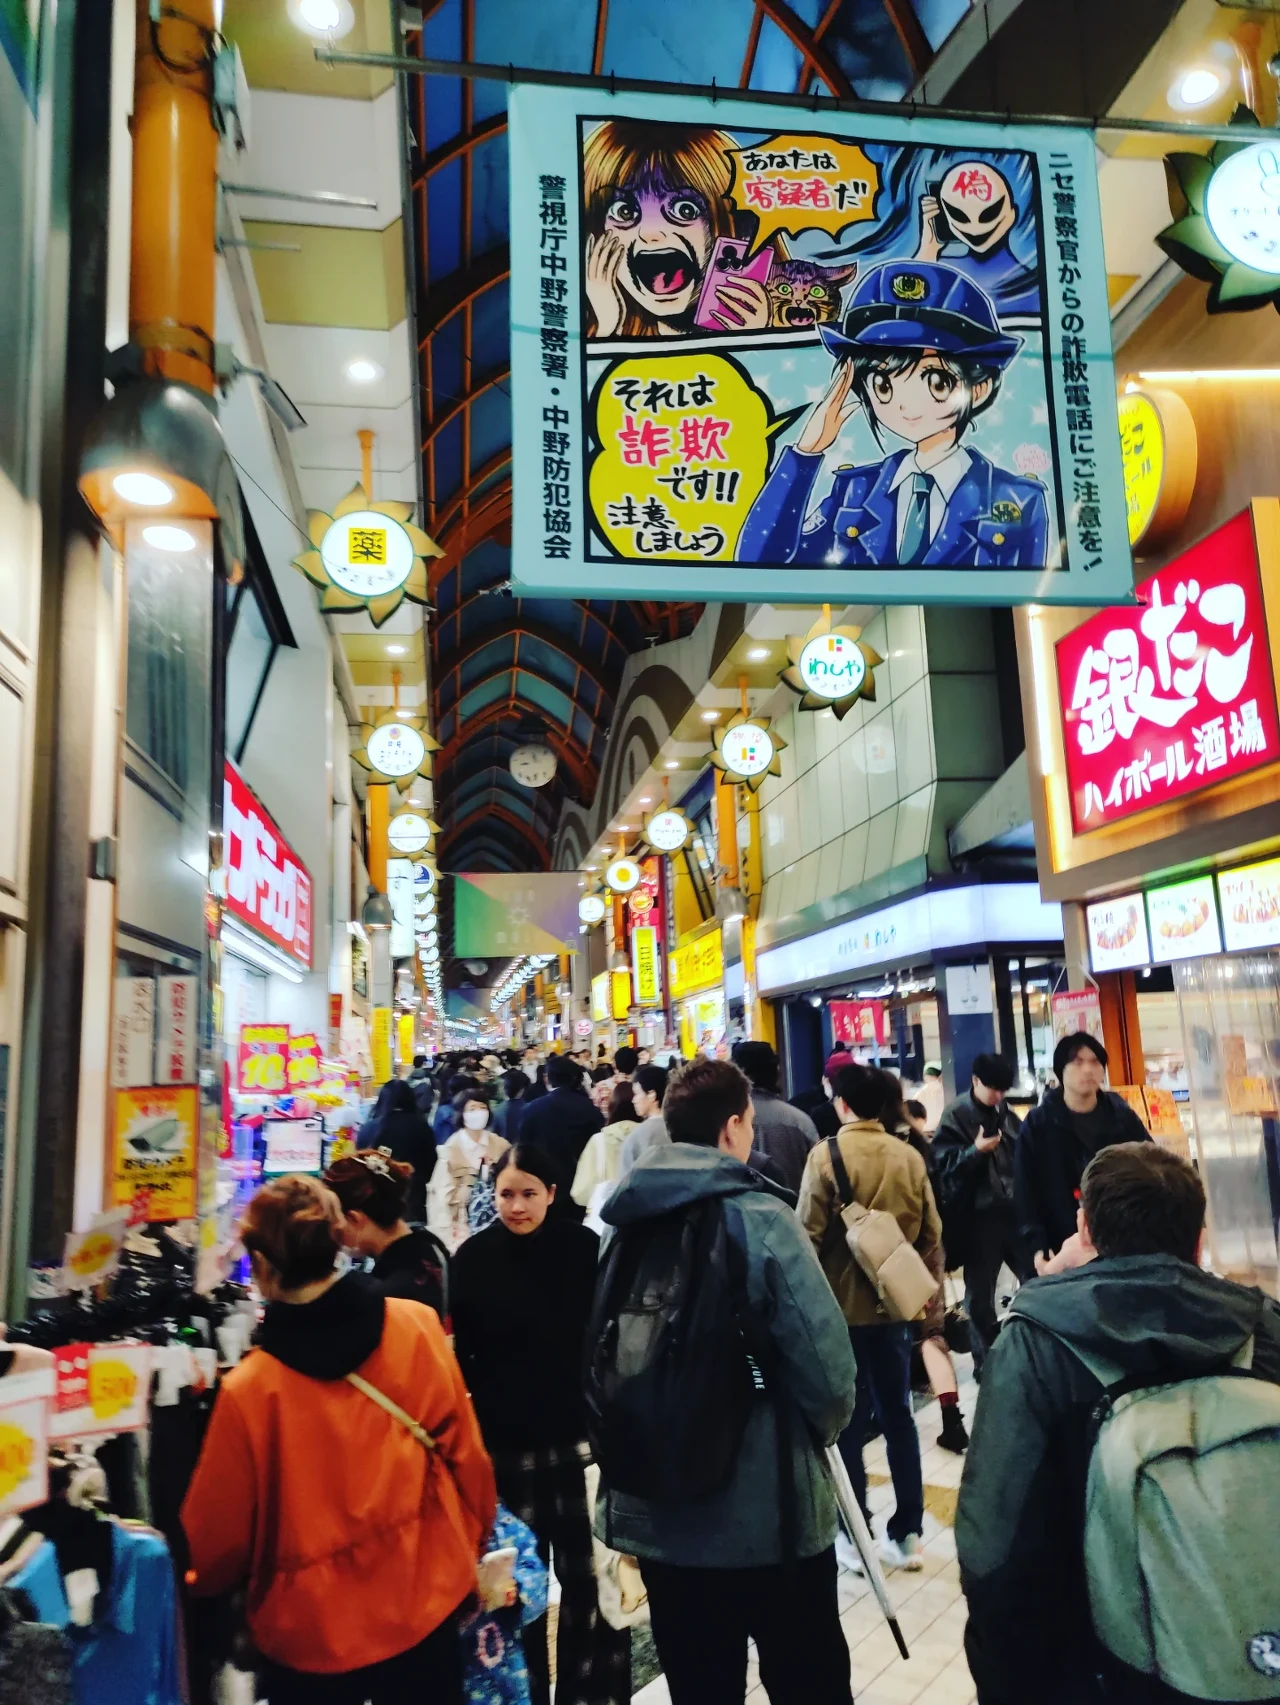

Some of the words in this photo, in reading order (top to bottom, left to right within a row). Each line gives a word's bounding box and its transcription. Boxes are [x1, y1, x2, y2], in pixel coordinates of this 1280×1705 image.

[745, 150, 837, 172] あなたは
[745, 176, 867, 210] 容疑者だ
[951, 169, 992, 202] 偽
[538, 174, 573, 560] 警視庁中野警察署・中野防犯協会
[1048, 153, 1104, 573] ニセ警察官からの詐欺電話にご注意を！
[613, 374, 716, 413] それは
[618, 415, 730, 467] 詐欺
[657, 466, 741, 503] です!!
[608, 496, 675, 530] 注意
[352, 531, 382, 562] 薬
[635, 526, 726, 558] しましょう
[1070, 578, 1254, 756] 銀だこ
[1083, 698, 1268, 820] ハイボール酒場
